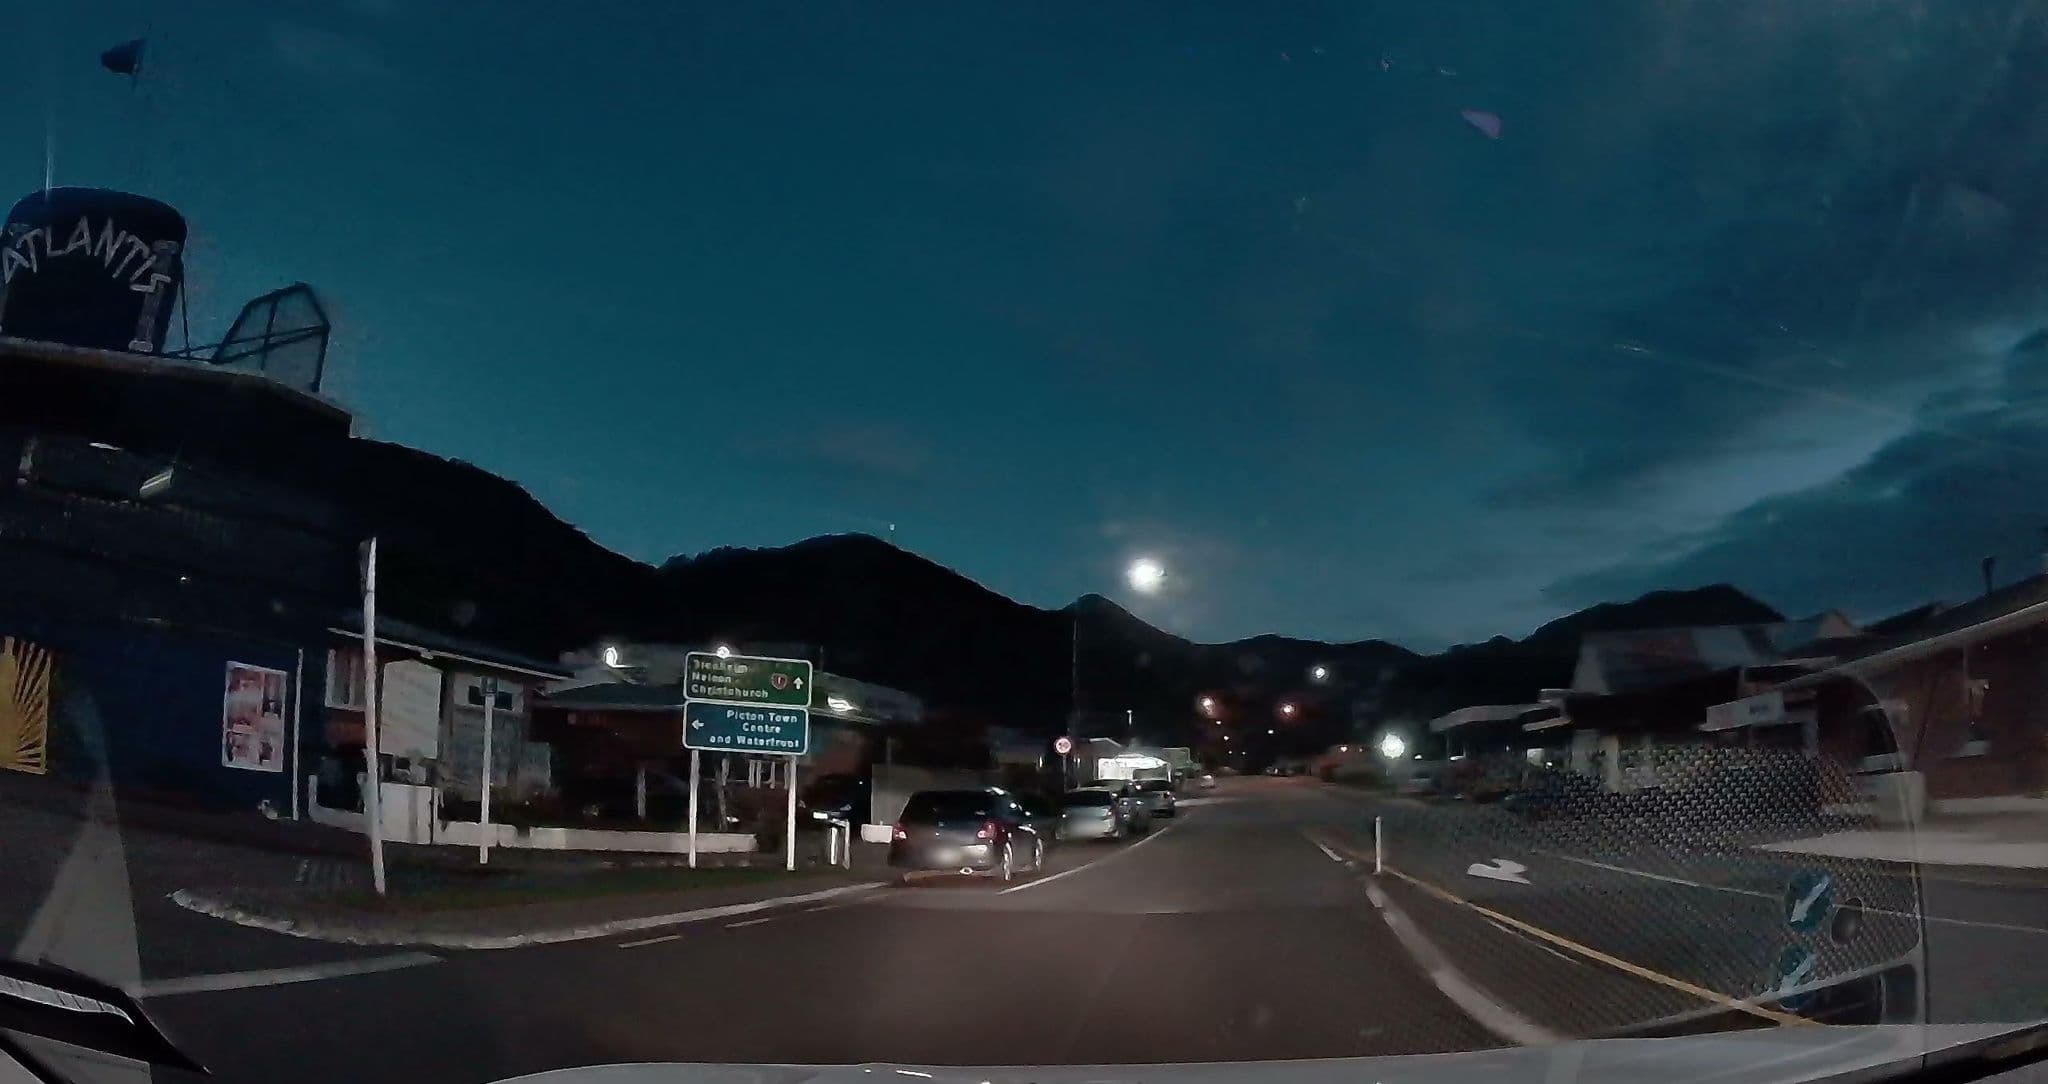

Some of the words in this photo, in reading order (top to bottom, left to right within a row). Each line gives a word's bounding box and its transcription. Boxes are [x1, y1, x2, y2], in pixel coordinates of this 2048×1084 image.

[2, 215, 171, 292] ATLANTIS
[690, 683, 769, 698] Christchurch
[726, 709, 764, 721] Picton
[768, 712, 798, 723] Town
[742, 722, 782, 734] Centre
[709, 735, 732, 744] and
[736, 735, 799, 748] Waterfront
